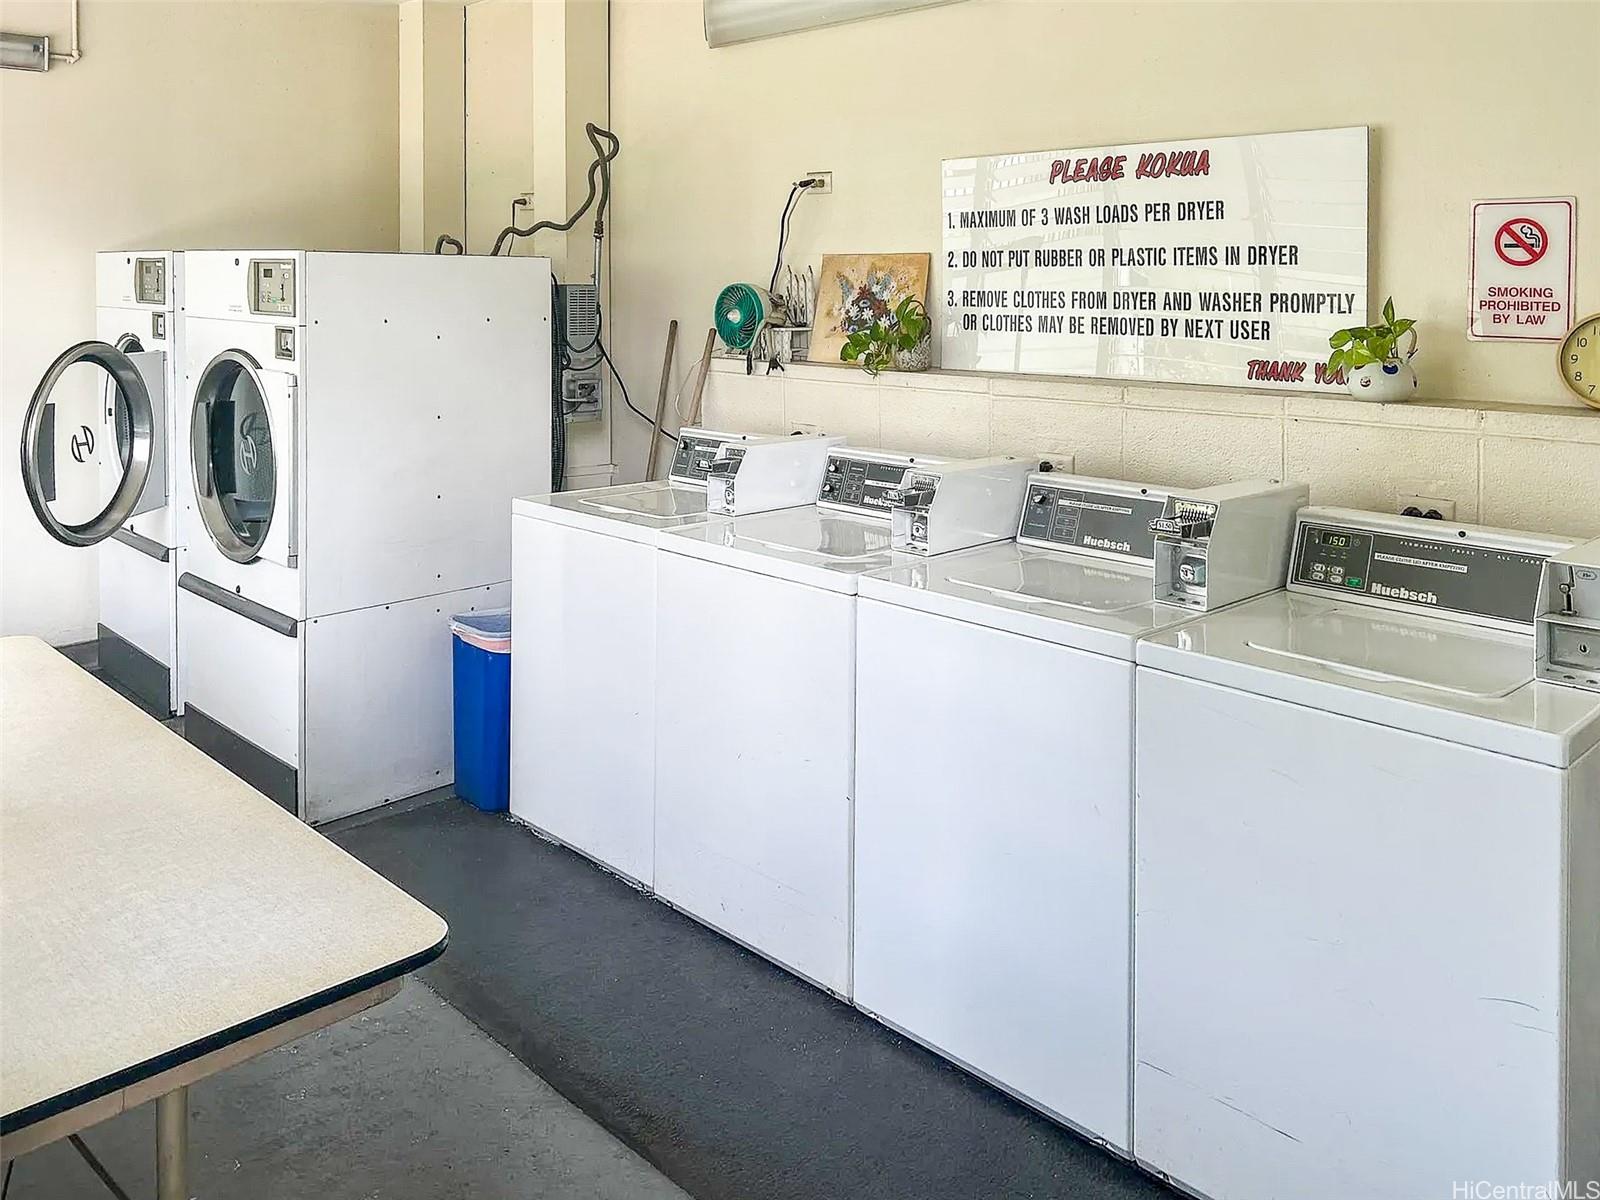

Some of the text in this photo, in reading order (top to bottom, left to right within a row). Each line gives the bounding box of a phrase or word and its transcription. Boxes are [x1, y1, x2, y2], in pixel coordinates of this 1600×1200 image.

[1049, 149, 1210, 184] PLEASE KOKUA
[948, 200, 1225, 229] 1. MAXIMUM OF 3 WASH LOADS PER DRYER
[948, 245, 1298, 268] 2. DO NOT PUT RUBBER OR PLASTIC ITEMS IN DRYER
[1488, 286, 1553, 299] SMOKING
[948, 290, 1355, 314] 3. REMOVE CLOTHES FROM DRYER AND WASHER PROMPTLY
[1479, 300, 1560, 312] PROHIBITED
[962, 314, 1271, 341] OR CLOTHES MAY BE REMOVED BY NEXT USER
[1493, 313, 1545, 325] BY LAW
[1577, 337, 1588, 348] 10
[1571, 354, 1578, 364] 9
[1247, 360, 1307, 383] THANK
[1574, 371, 1582, 381] 8
[1589, 385, 1596, 394] 7
[1083, 535, 1131, 552] Huebsch
[1371, 582, 1437, 604] Huebsch
